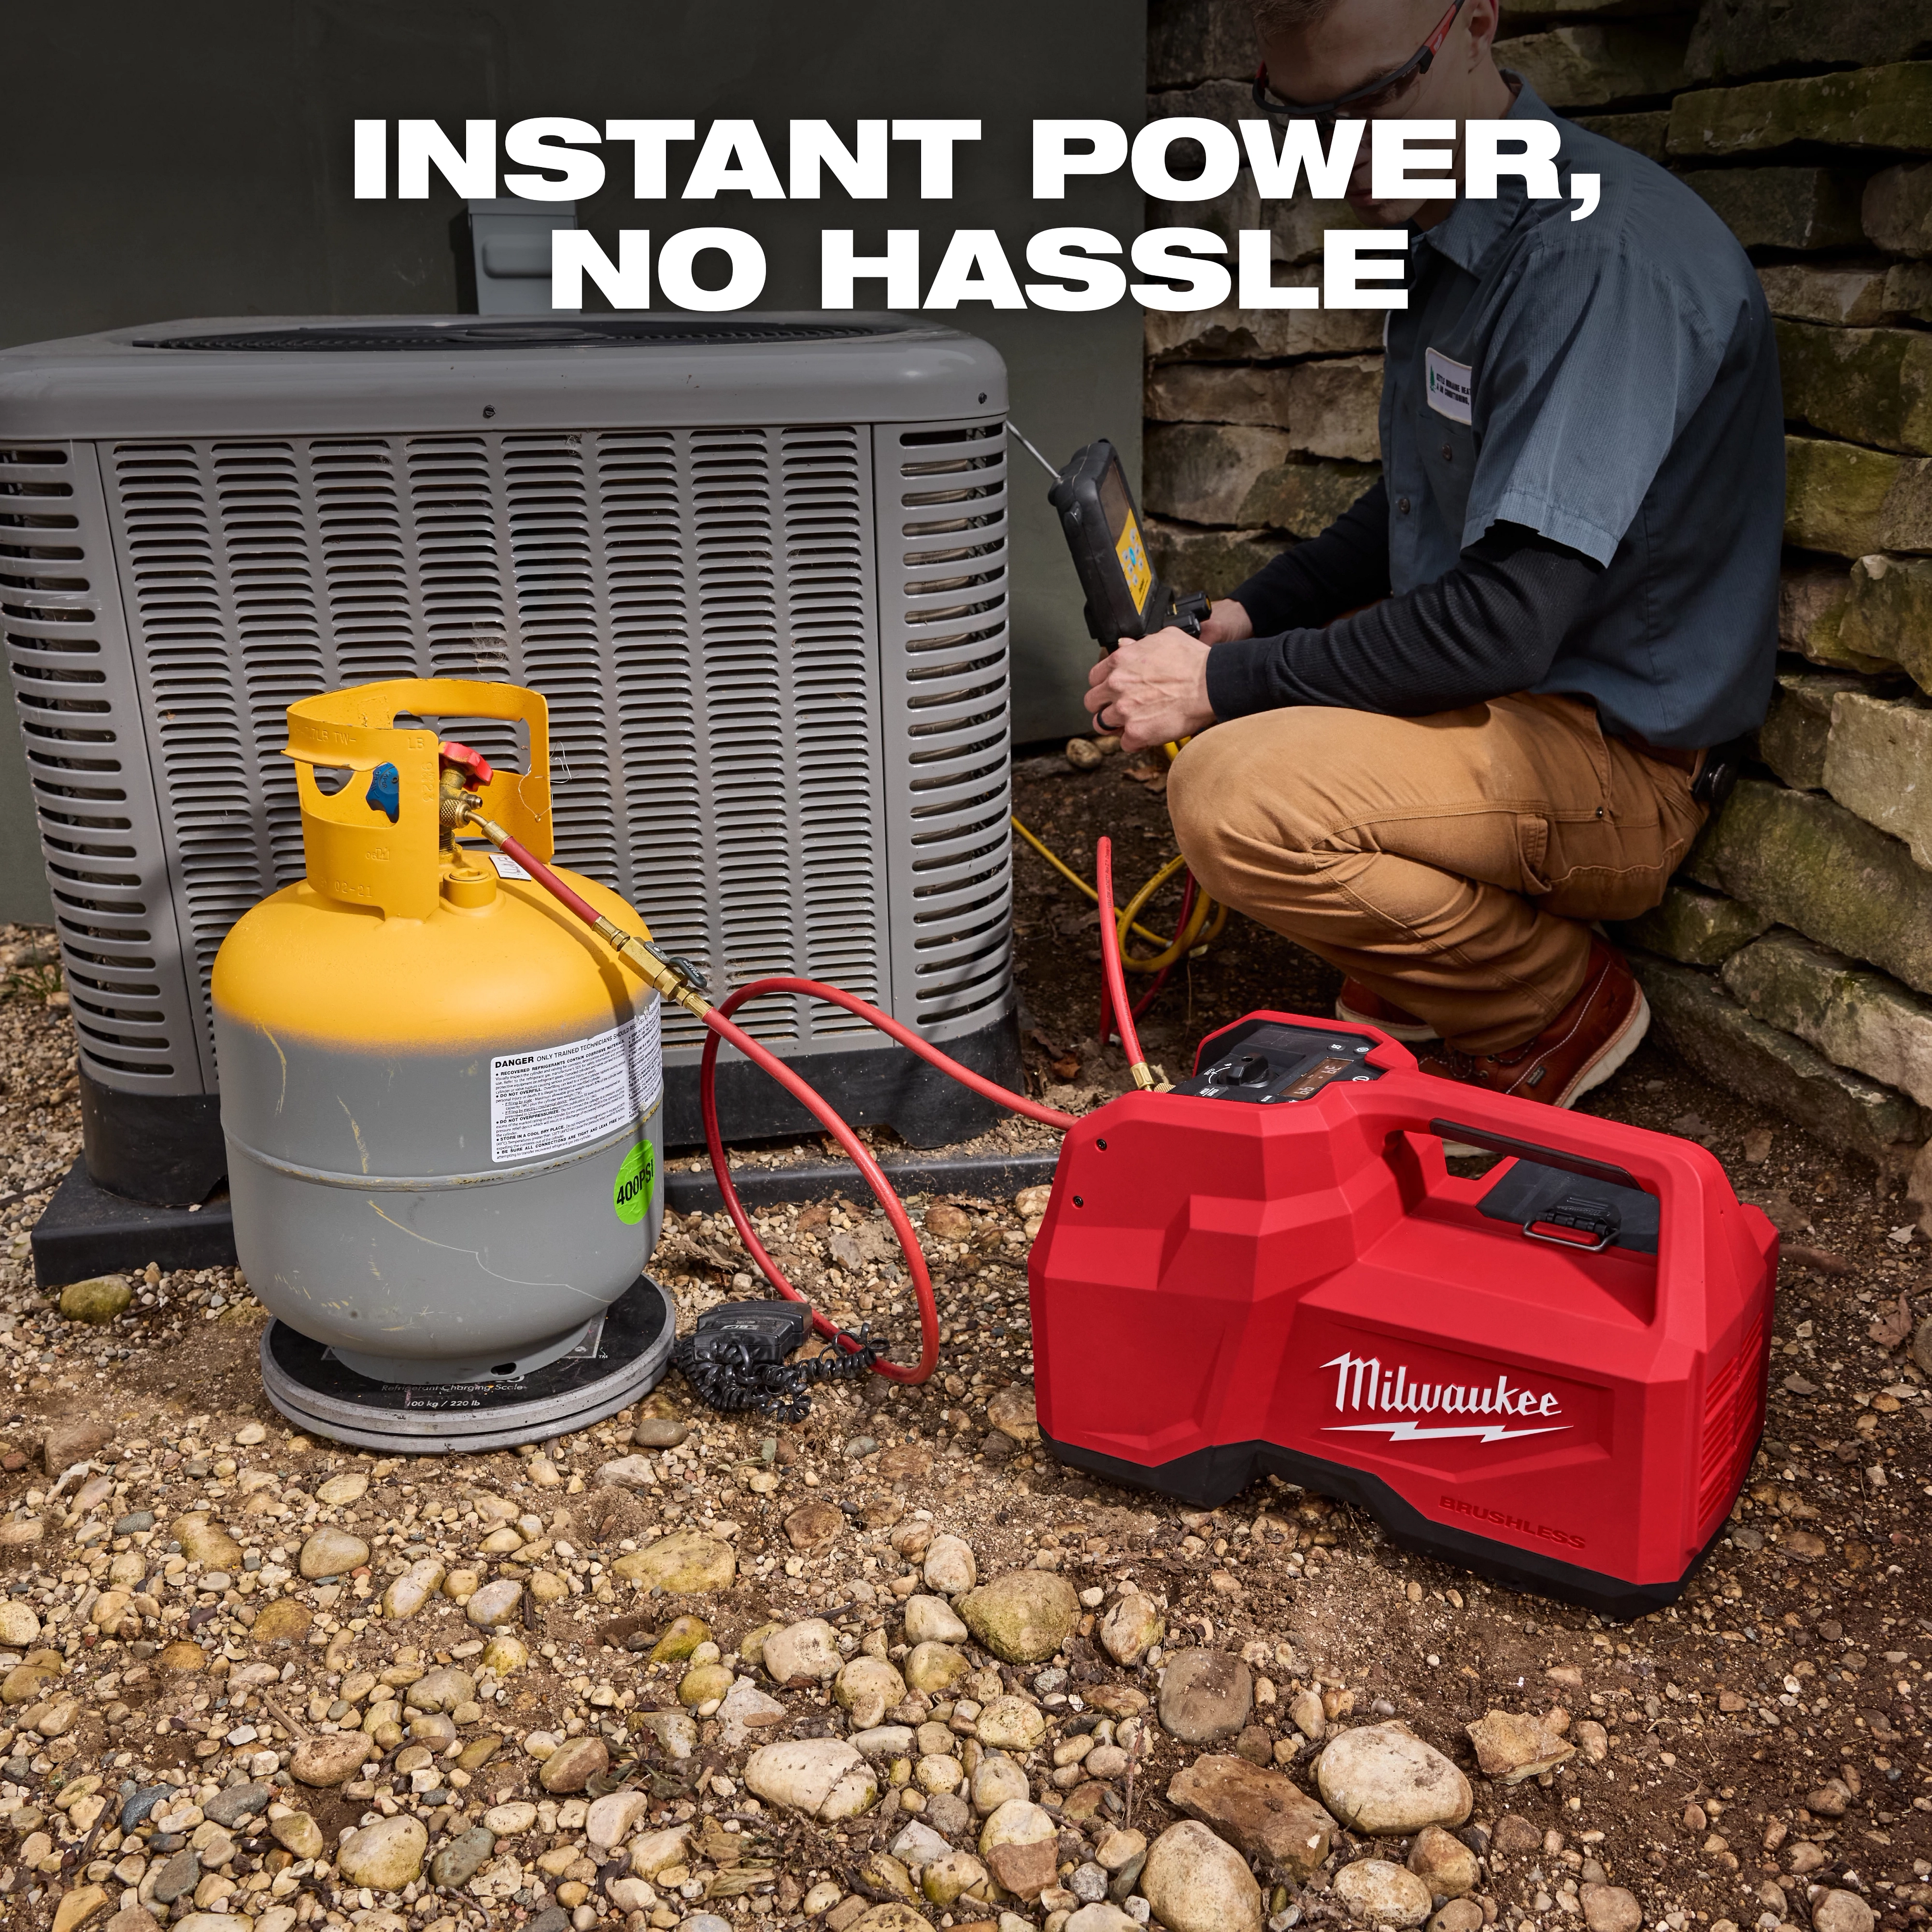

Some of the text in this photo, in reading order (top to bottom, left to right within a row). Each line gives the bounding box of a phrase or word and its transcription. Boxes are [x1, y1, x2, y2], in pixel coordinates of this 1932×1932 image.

[335, 880, 373, 898] 02-21
[683, 961, 699, 977] BETTER
[689, 963, 699, 974] JUST
[495, 1057, 534, 1068] DANGER
[554, 1048, 579, 1058] TRAINED
[580, 1036, 612, 1051] TECHNICIANS
[613, 1028, 629, 1039] SHOULD
[532, 1061, 565, 1071] REFRIGERANTS
[520, 1109, 560, 1120] OVERPRESSURIZE.
[536, 1137, 566, 1148] CONNECTIONS
[616, 1158, 654, 1206] 400PSI
[1319, 1350, 1562, 1416] Milwaukee
[1439, 1495, 1585, 1549] BRUSHLESS
